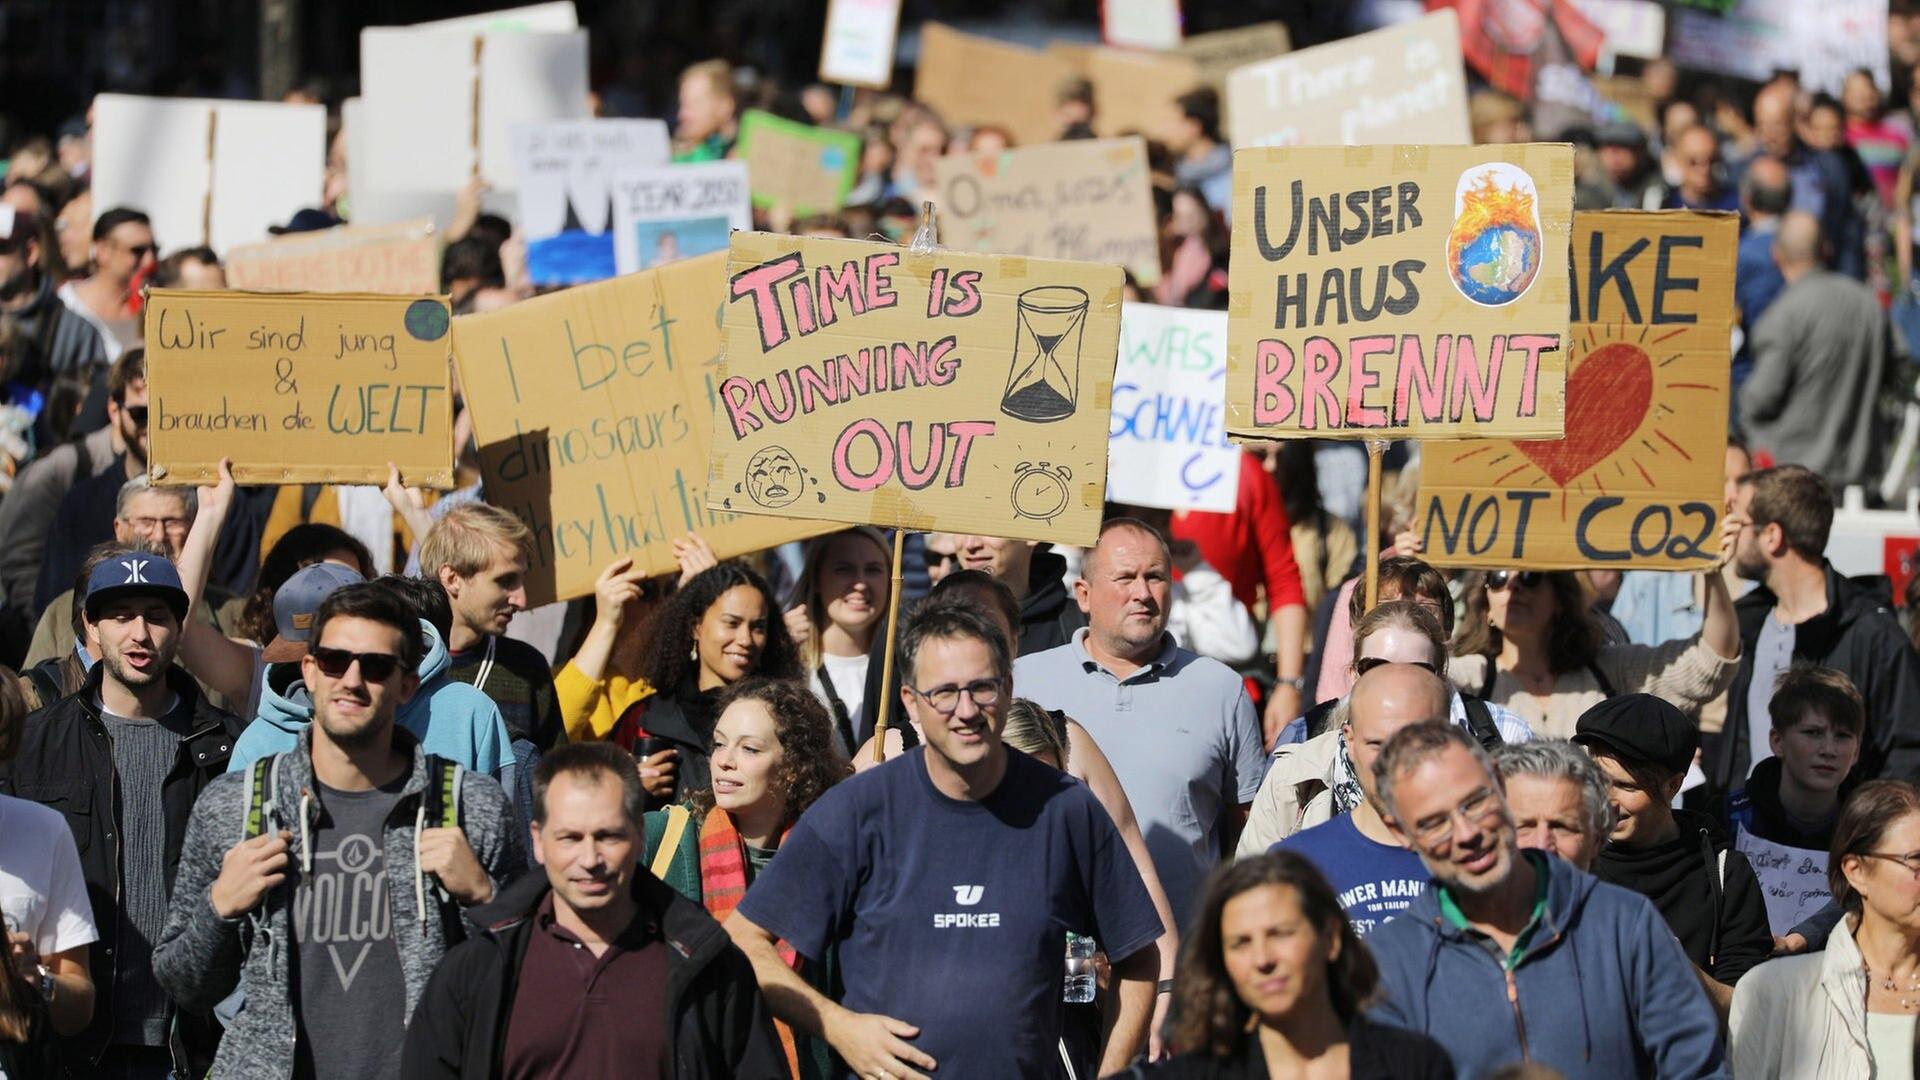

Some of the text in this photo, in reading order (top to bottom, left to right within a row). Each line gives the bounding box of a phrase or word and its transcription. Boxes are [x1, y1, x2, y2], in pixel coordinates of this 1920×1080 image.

[1254, 179, 1424, 262] UNSER
[729, 251, 983, 353] TIME IS
[1274, 259, 1427, 329] HAUS
[159, 307, 397, 371] Wir sind jung
[501, 335, 521, 404] I
[1121, 320, 1215, 371] WAS
[159, 384, 445, 435] brauchen die WELT
[274, 357, 298, 394] &
[719, 335, 962, 441] RUNNING
[1253, 334, 1561, 429] BRENNT
[500, 403, 690, 483] dinosaurs
[831, 417, 996, 492] OUT
[596, 482, 667, 554] had
[1421, 490, 1721, 561] NOT CO2
[1367, 902, 1383, 912] TOM
